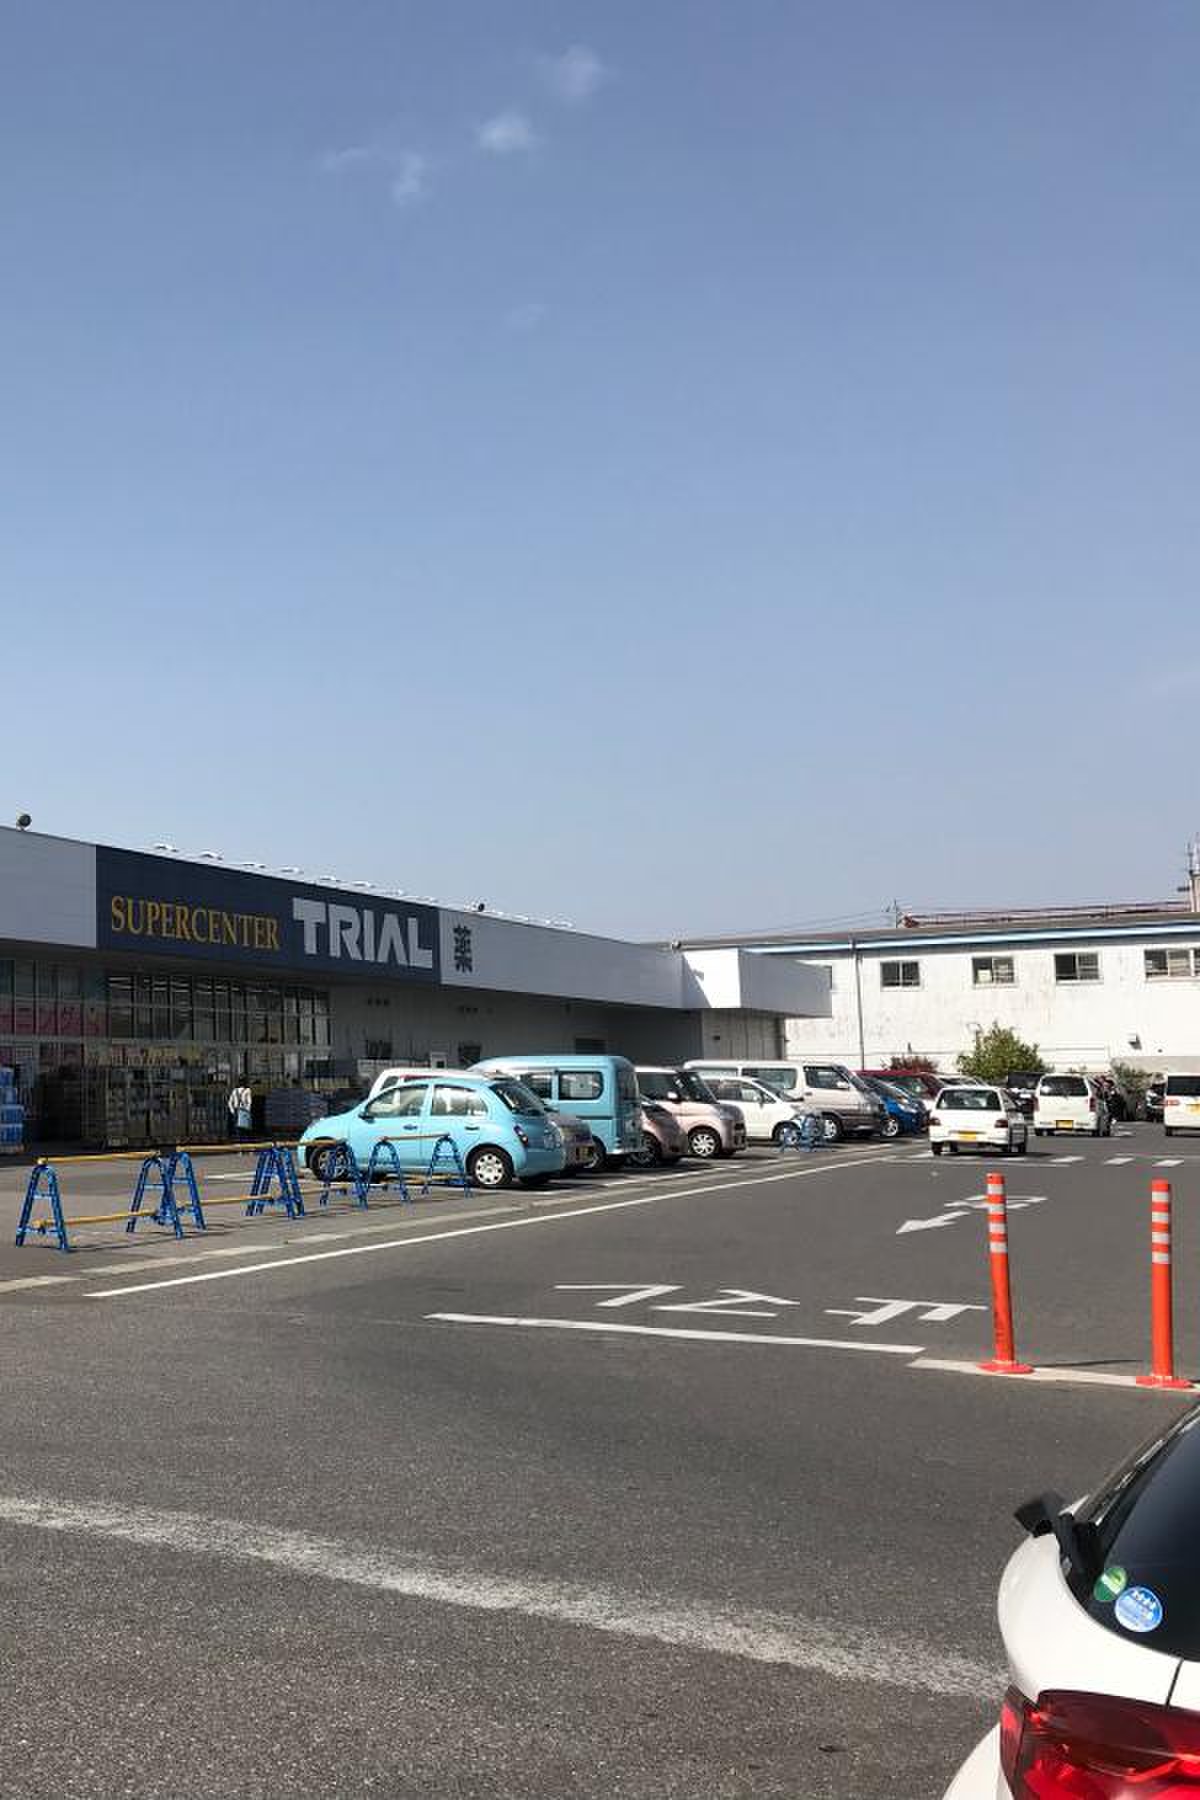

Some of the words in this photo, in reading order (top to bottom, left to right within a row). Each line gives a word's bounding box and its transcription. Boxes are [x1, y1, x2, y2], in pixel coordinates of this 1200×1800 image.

[110, 894, 280, 951] SUPERCENTER
[292, 897, 433, 969] TRIAL
[452, 923, 474, 974] 薬
